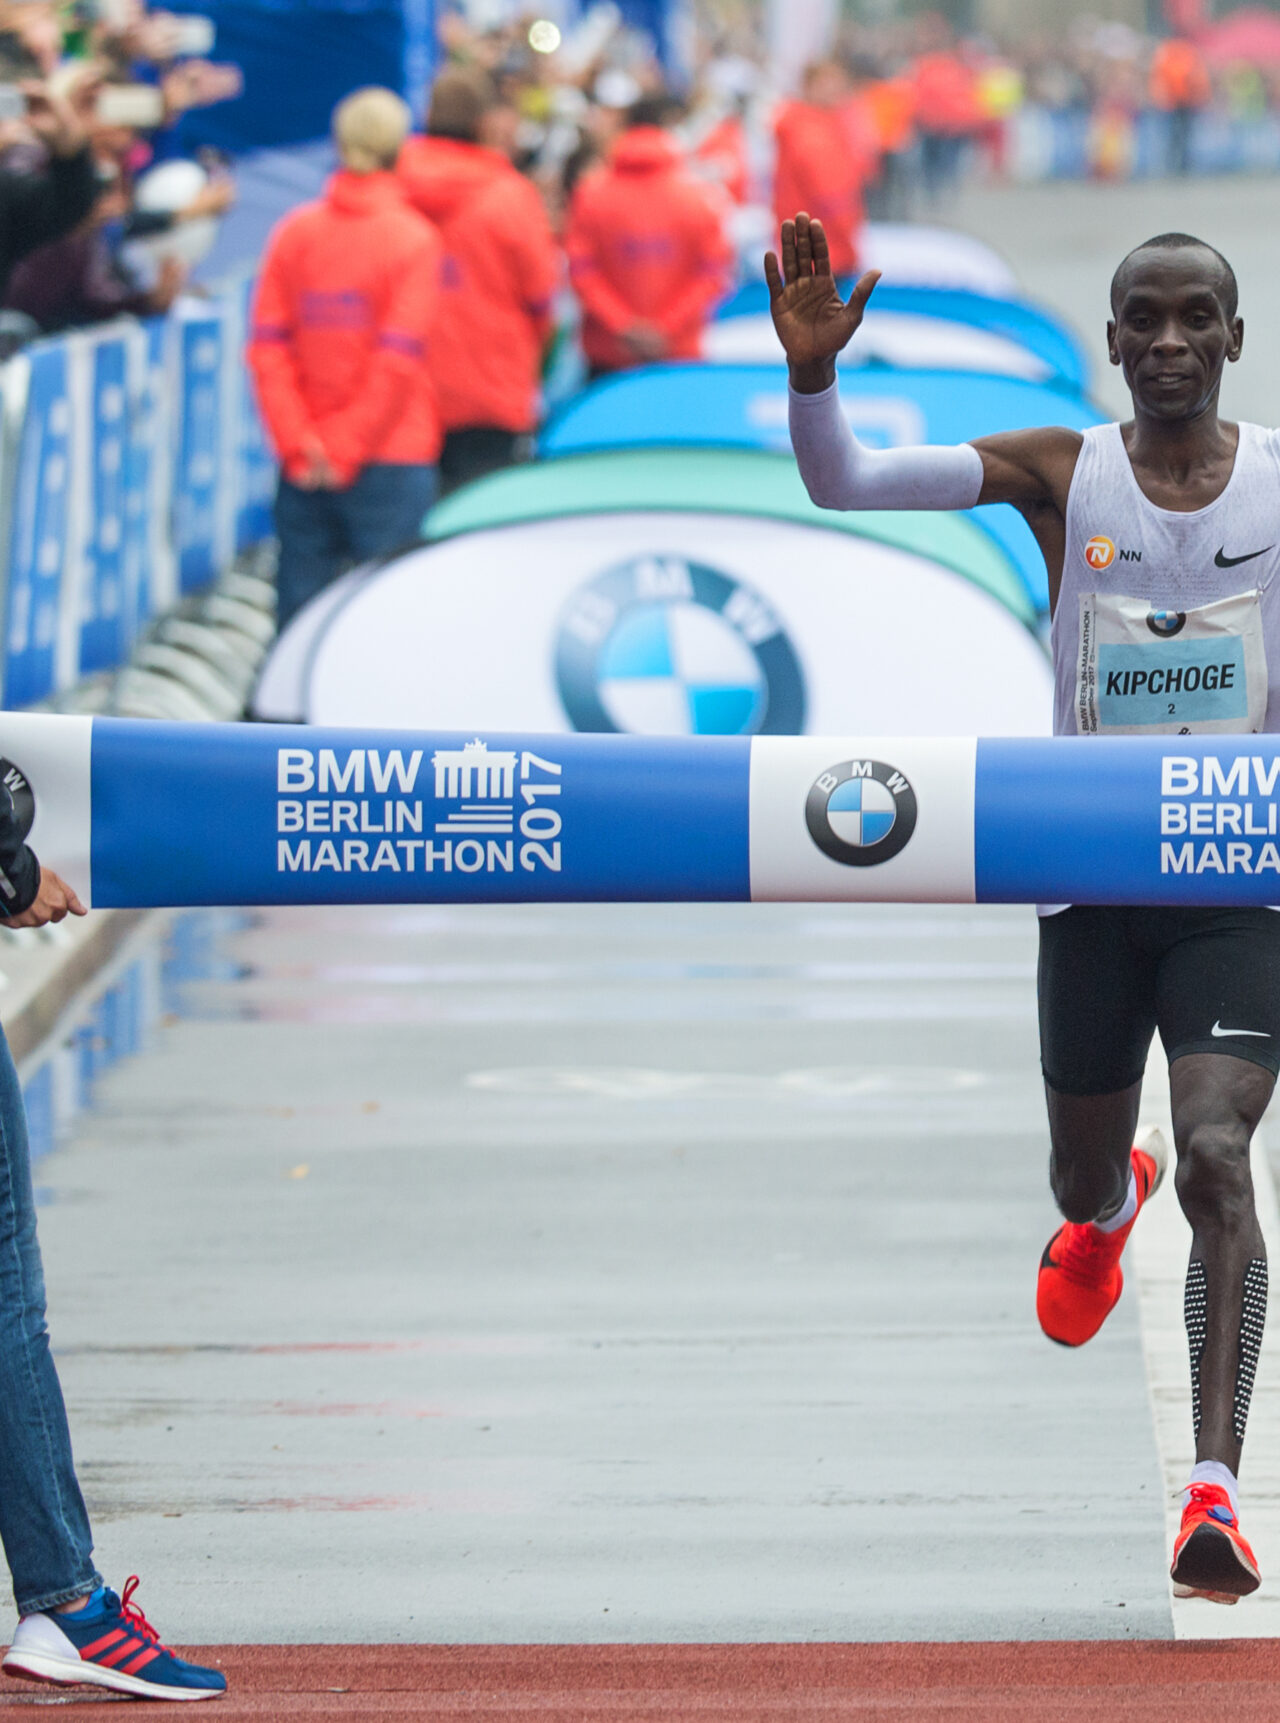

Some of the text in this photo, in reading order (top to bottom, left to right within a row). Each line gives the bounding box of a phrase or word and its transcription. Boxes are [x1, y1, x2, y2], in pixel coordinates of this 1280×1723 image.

[1119, 549, 1142, 562] NN
[568, 557, 784, 646] BMW
[1088, 666, 1096, 686] 2017
[1105, 663, 1236, 696] KIPCHOGE
[1079, 708, 1090, 732] BMW
[1167, 703, 1176, 715] 2
[277, 749, 424, 793] BMW
[815, 761, 909, 795] BMW
[277, 801, 423, 833] BERLIN
[520, 752, 563, 872] 2017
[277, 840, 514, 873] MARATHON
